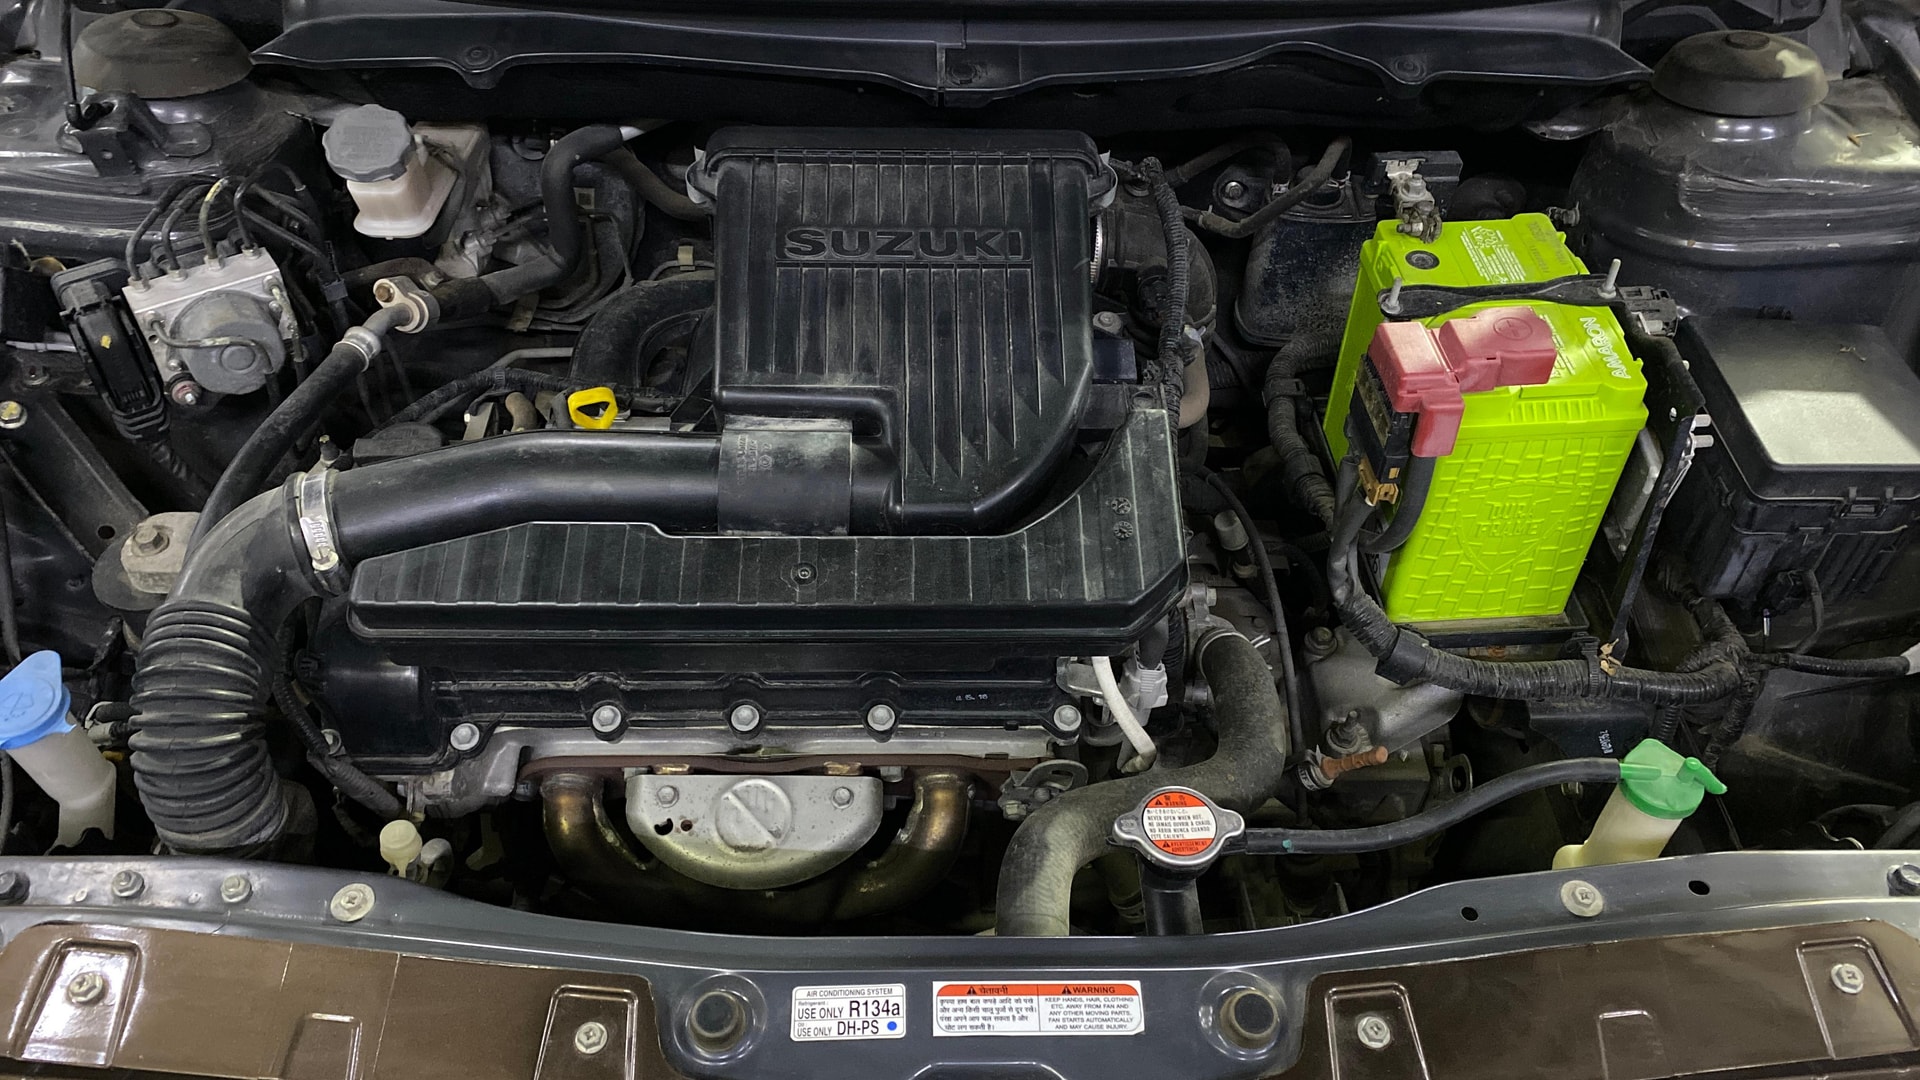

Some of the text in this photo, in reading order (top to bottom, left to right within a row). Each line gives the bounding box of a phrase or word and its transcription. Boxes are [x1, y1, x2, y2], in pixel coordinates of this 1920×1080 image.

[784, 228, 1024, 259] SUZUKI
[1580, 317, 1631, 379] AMARON
[1478, 521, 1540, 537] FRAME
[979, 985, 1008, 994] चेतावनी
[798, 999, 900, 1019] USE ONLY R134a
[797, 1020, 879, 1037] USE ONLY DH-PS
